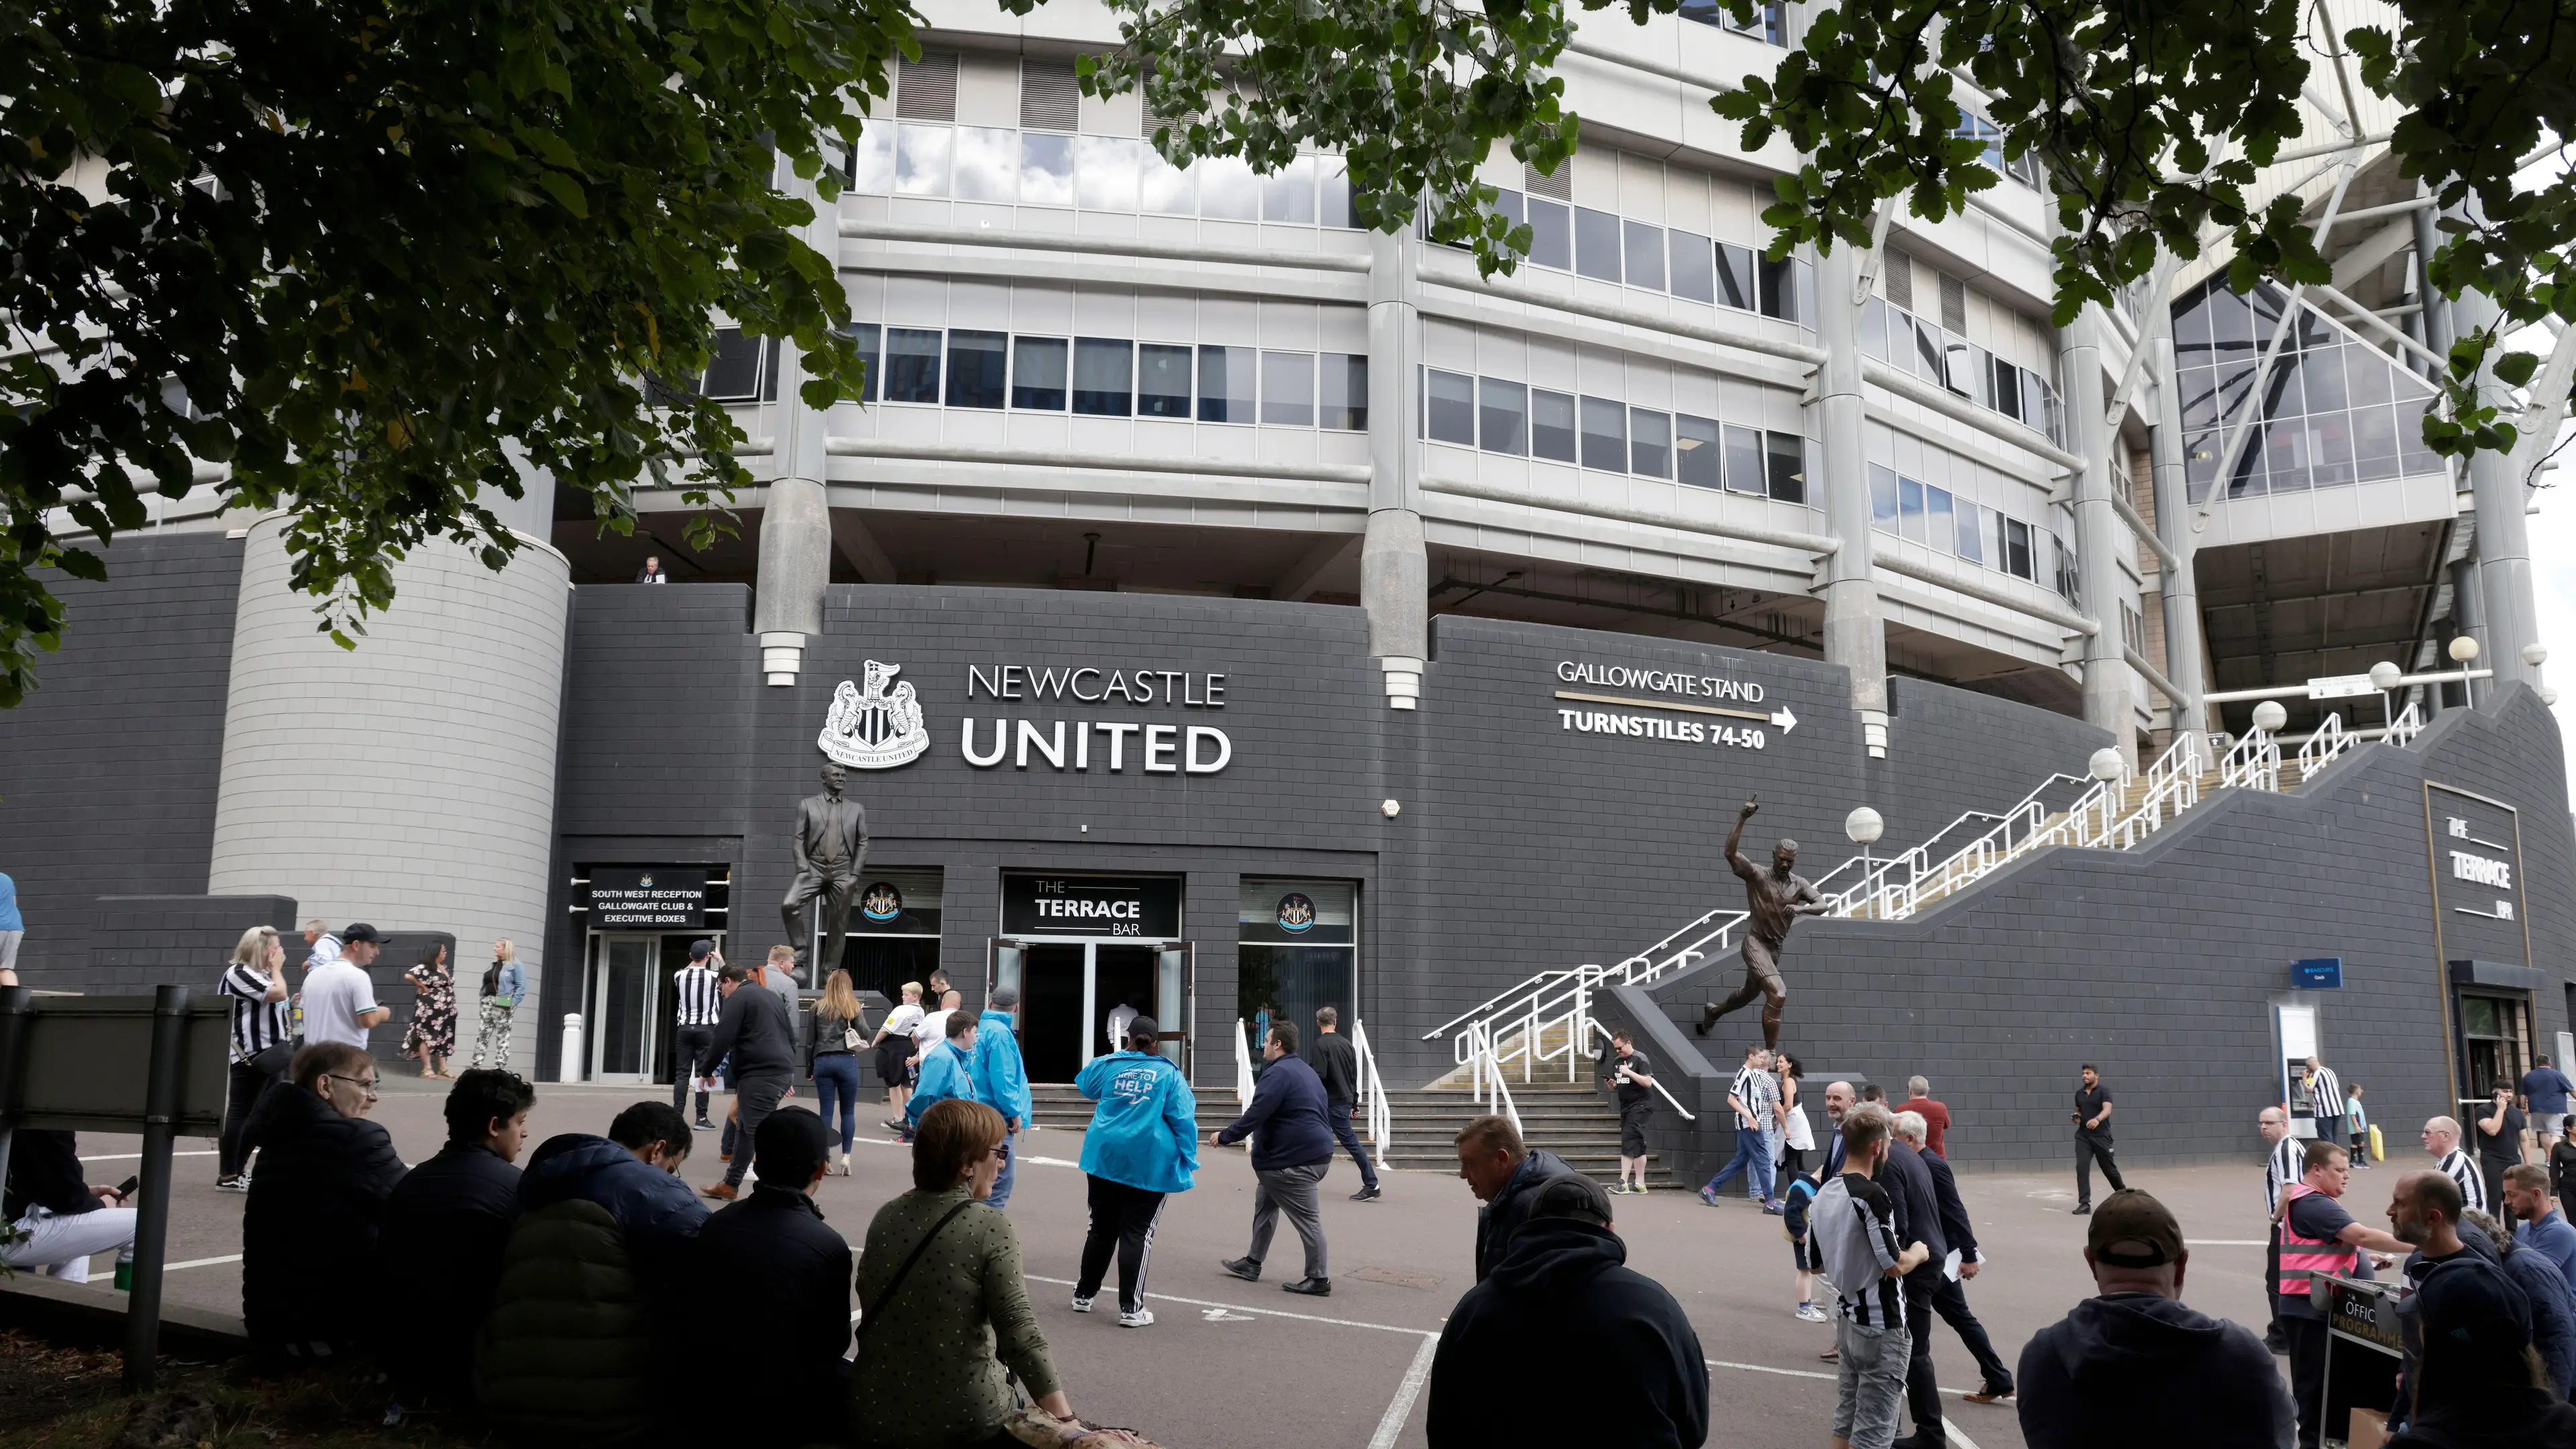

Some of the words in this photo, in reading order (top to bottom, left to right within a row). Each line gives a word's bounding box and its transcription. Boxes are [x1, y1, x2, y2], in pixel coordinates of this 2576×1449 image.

[968, 663, 1226, 706] NEWCASTLE
[1556, 661, 1698, 696] GALLOWGATE
[1701, 677, 1764, 703] STAND
[1558, 709, 1705, 743] TURNSTILES
[1709, 724, 1766, 750] 74-50
[961, 717, 1232, 774] UNITED
[834, 749, 881, 763] NEWCASTLE
[883, 749, 914, 763] UNITED
[2446, 816, 2469, 839] THE
[2449, 851, 2512, 890] TERRACE
[592, 890, 623, 899] SOUTH
[624, 890, 650, 899] WEST
[651, 890, 702, 899] RECEPTION
[1035, 880, 1065, 894] THE
[598, 902, 659, 910] GALLOWGATE
[661, 902, 685, 910] CLUB
[1034, 899, 1140, 918] TERRACE
[2496, 900, 2515, 921] BAR
[604, 914, 653, 923] EXECUTIVE
[655, 914, 686, 923] BOXES
[1112, 923, 1140, 936] BAR
[1114, 1079, 1153, 1093] HELP
[1118, 1072, 1138, 1080] HERE
[2345, 1301, 2377, 1324] OFFIC
[2332, 1313, 2402, 1348] PROGRAMME
